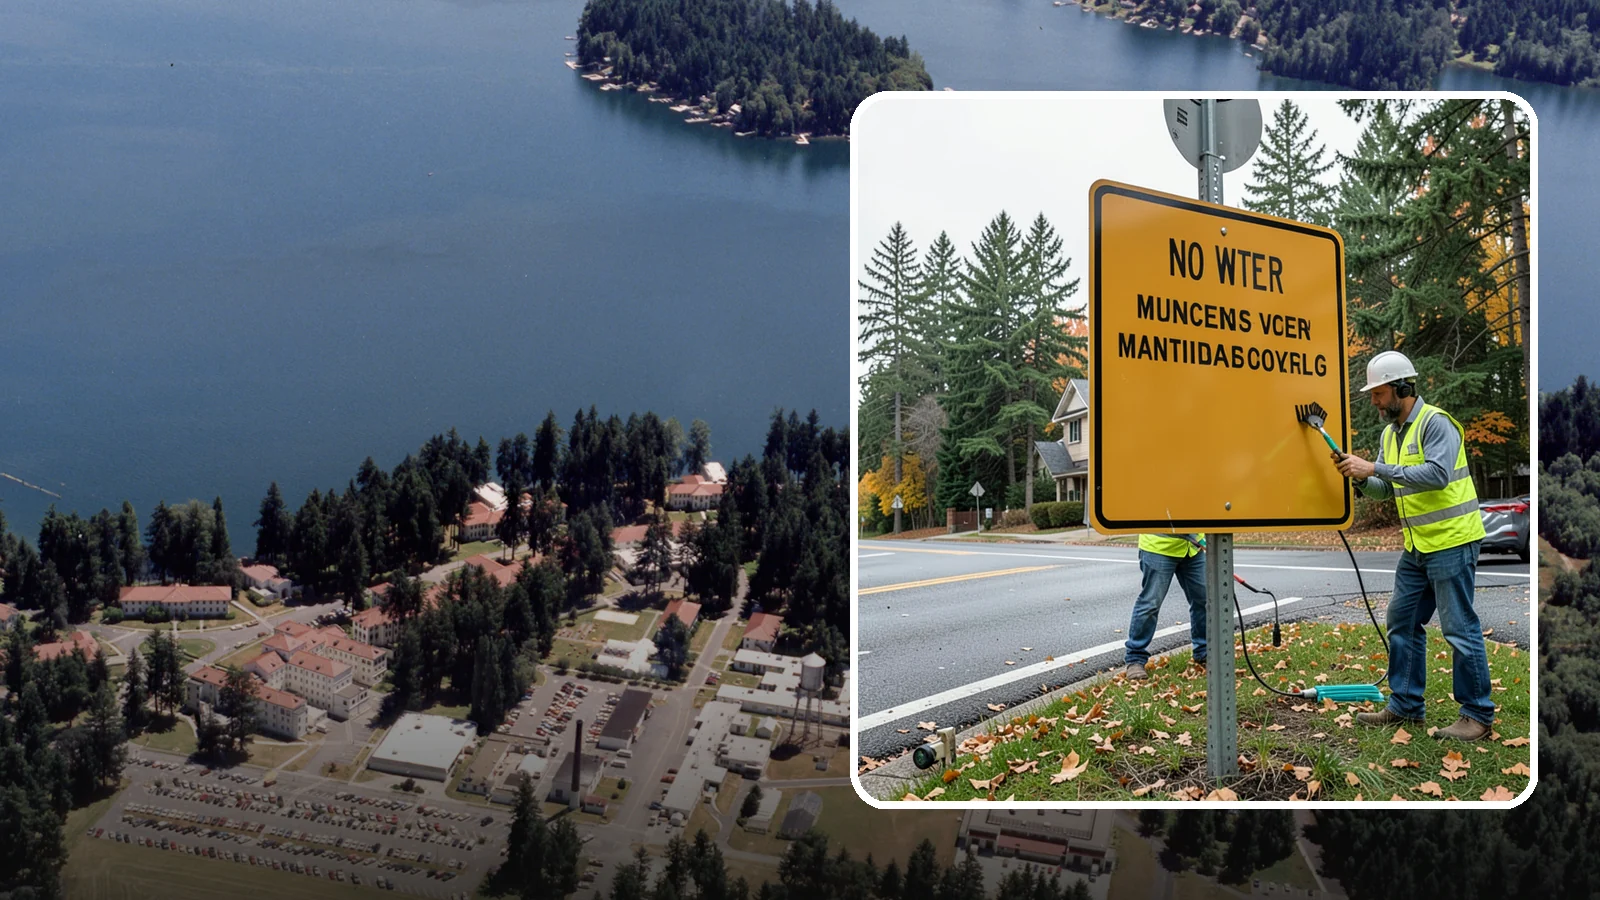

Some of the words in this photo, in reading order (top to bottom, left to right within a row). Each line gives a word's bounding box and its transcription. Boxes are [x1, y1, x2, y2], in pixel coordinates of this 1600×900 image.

[1169, 237, 1204, 281] NO
[1215, 245, 1284, 295] WTER
[1137, 293, 1251, 333] MUNCENS
